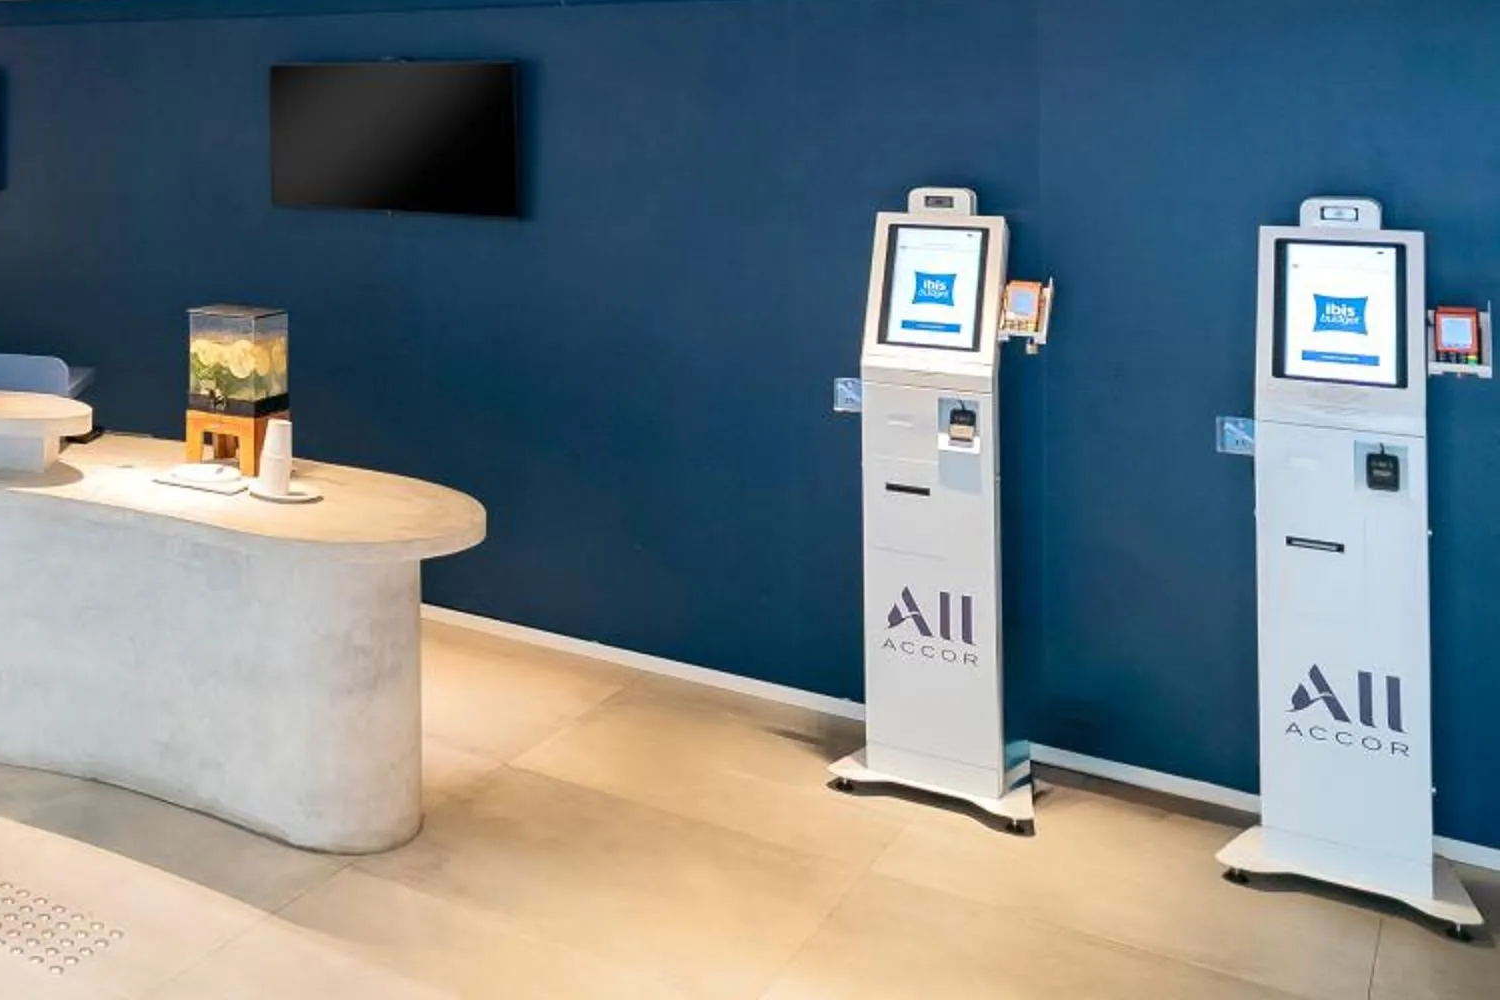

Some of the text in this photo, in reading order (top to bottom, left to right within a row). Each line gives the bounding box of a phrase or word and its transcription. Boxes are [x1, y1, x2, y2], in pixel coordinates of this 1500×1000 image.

[1325, 301, 1356, 316] ibis
[882, 638, 978, 667] ACCOR
[1285, 721, 1410, 757] ACCOR
